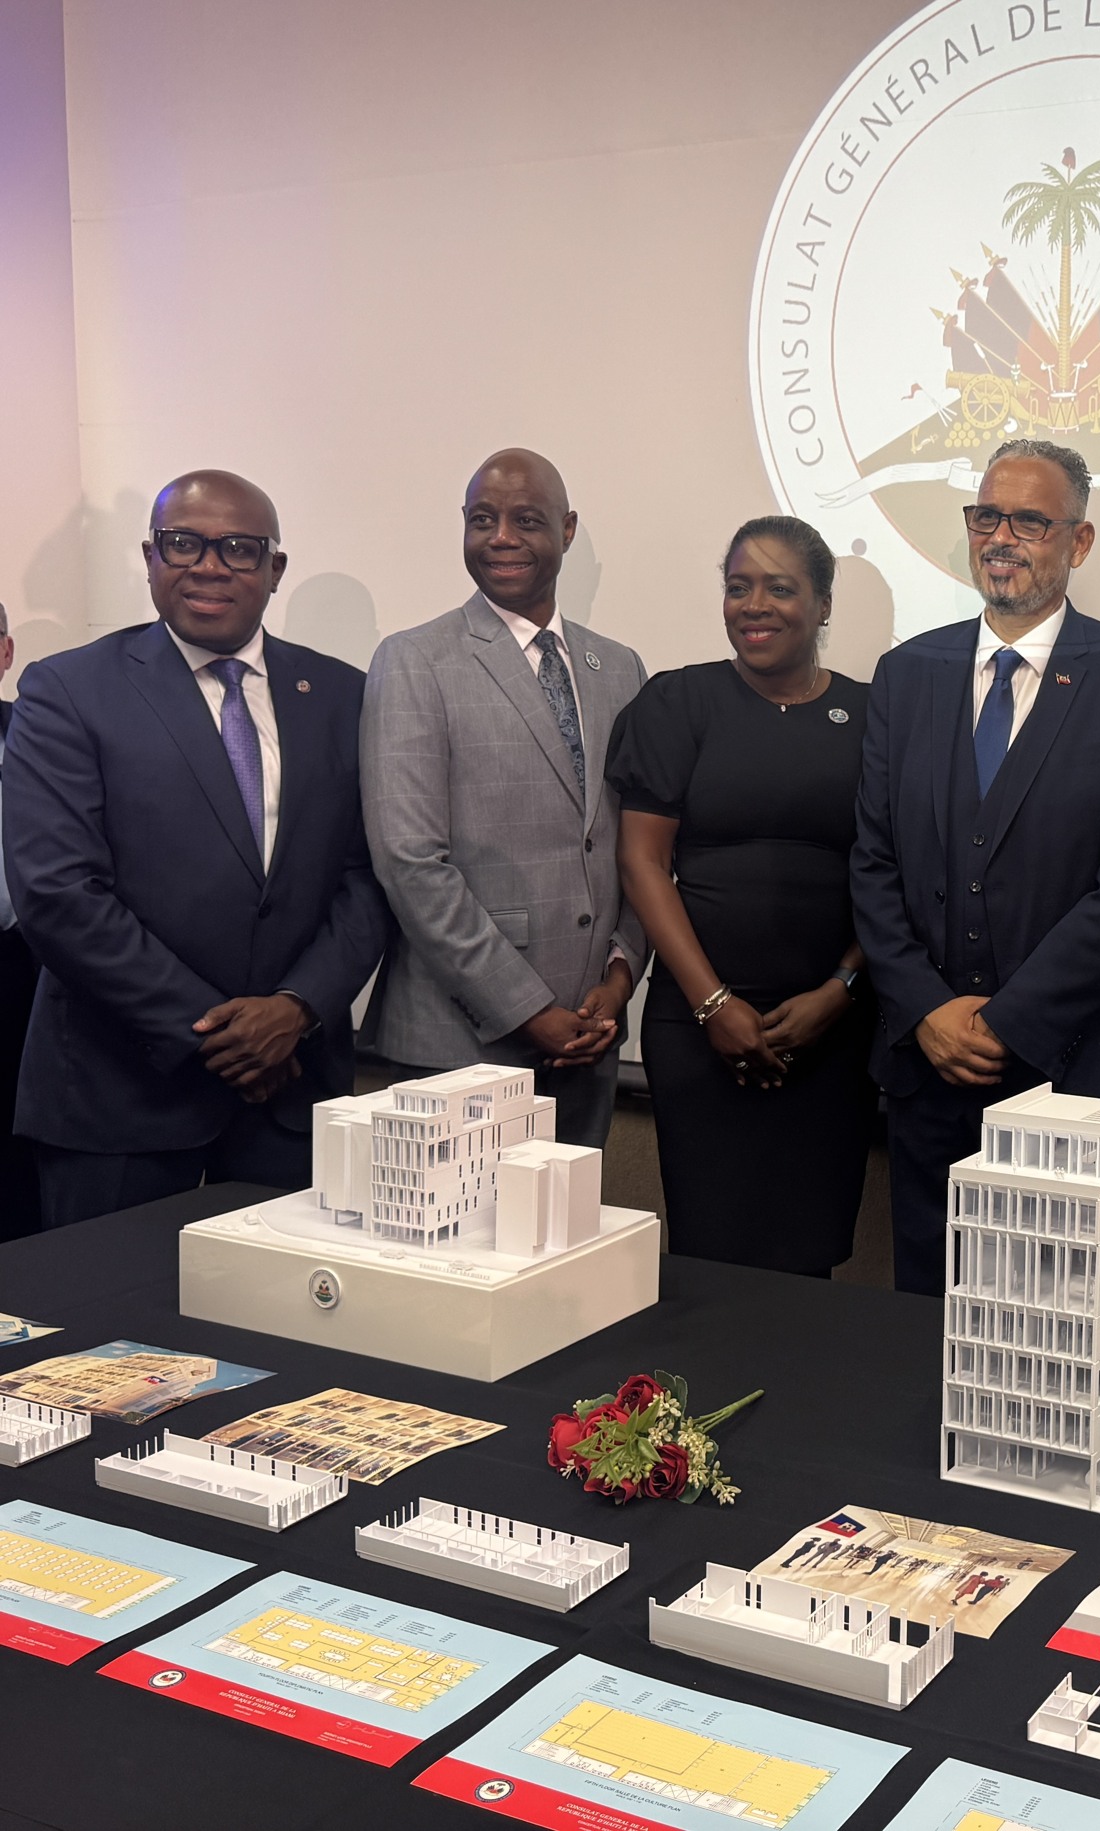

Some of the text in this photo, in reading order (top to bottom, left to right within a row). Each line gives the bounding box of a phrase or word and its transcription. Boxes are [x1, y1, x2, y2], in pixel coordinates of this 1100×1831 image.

[781, 202, 832, 467] CONSULAT
[824, 23, 996, 195] GÉNÉRAL
[1007, 0, 1063, 42] DE
[584, 1779, 598, 1787] FIFTH
[598, 1784, 616, 1792] FLOOR
[644, 1798, 668, 1809] CULTURE
[566, 1803, 599, 1816] CONSULAT
